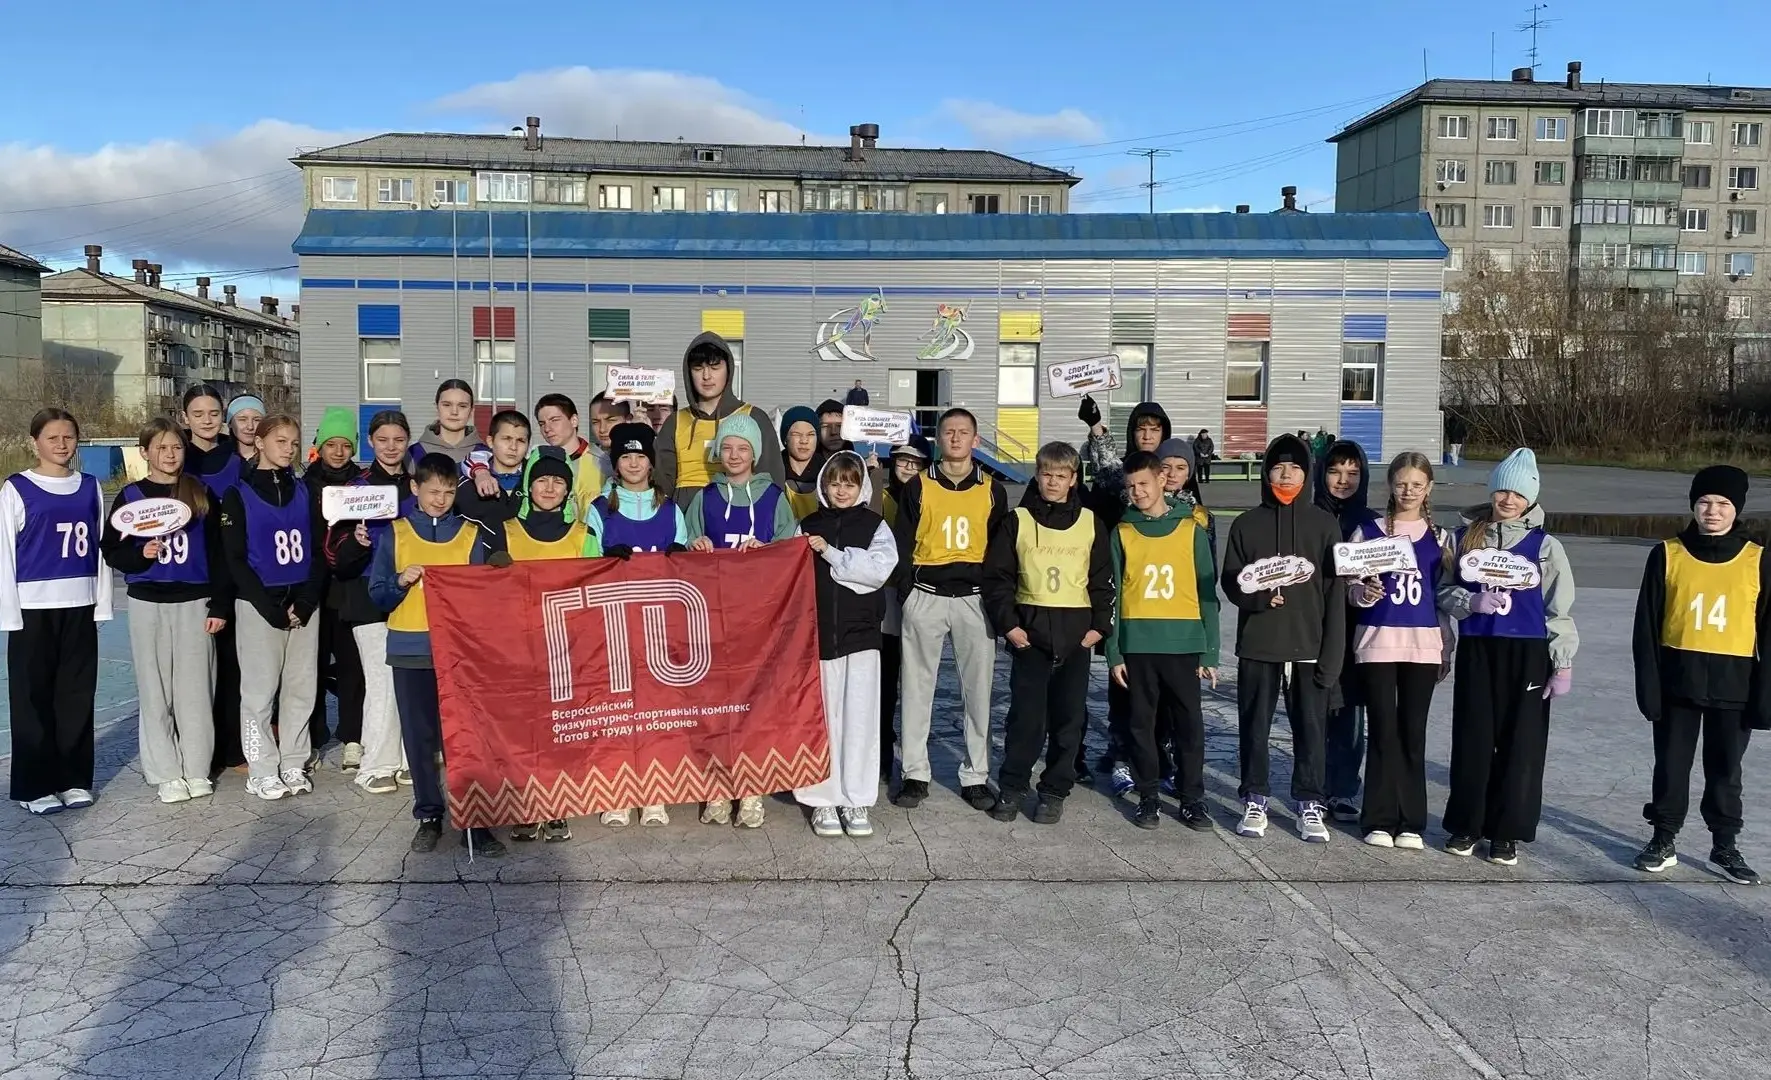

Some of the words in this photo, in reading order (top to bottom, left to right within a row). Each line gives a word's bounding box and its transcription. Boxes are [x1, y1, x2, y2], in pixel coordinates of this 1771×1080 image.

[1068, 364, 1090, 374] СПОРТ
[1083, 368, 1104, 378] ЖИЗНИ!
[138, 505, 161, 514] КАЖДЫЙ
[343, 494, 385, 505] ДВИГАЙСЯ
[357, 503, 381, 511] ЦЕЛИ!
[56, 521, 88, 558] 78
[941, 515, 969, 550] 18
[158, 530, 188, 564] 89
[274, 529, 303, 565] 88
[1355, 544, 1395, 554] ПРЕОДОЛЕВАЙ
[1254, 559, 1290, 573] ДВИГАЙСЯ
[1266, 565, 1286, 575] ЦЕЛИ!
[1047, 566, 1060, 594] 8
[1144, 564, 1174, 600] 23
[1390, 570, 1422, 606] 36
[1690, 592, 1726, 632] 14
[541, 578, 712, 702] ГТО
[551, 699, 634, 721] Всероссийский
[552, 706, 699, 734] физкультурно-спортивный
[701, 702, 750, 716] комплекс
[553, 730, 589, 744] «Готов
[592, 729, 600, 738] к
[601, 725, 633, 739] труду
[636, 724, 643, 733] и
[646, 719, 698, 731] обороне»
